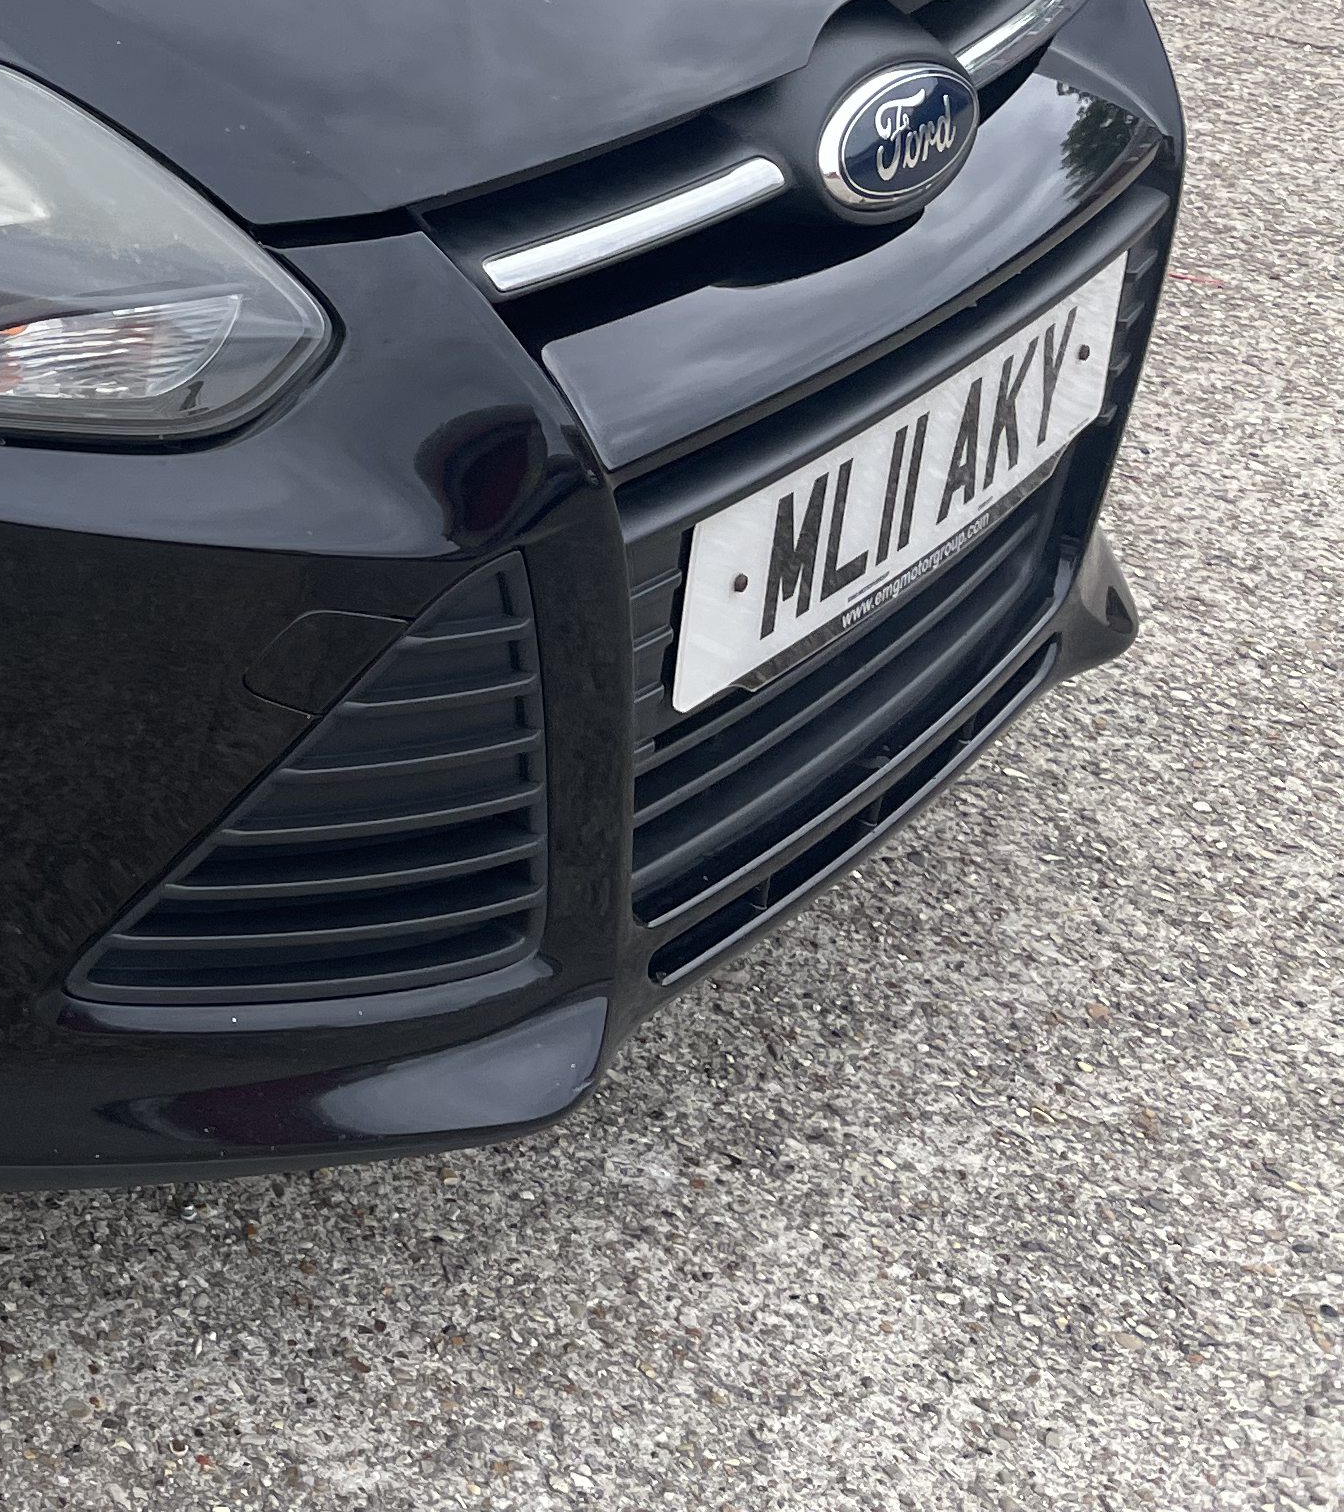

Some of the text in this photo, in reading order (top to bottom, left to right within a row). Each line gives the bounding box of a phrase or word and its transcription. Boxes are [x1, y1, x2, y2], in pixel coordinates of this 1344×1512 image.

[874, 88, 957, 181] Ford
[759, 306, 1078, 641] ML11 AKY
[841, 512, 990, 629] www.emgmotorgroup.com
